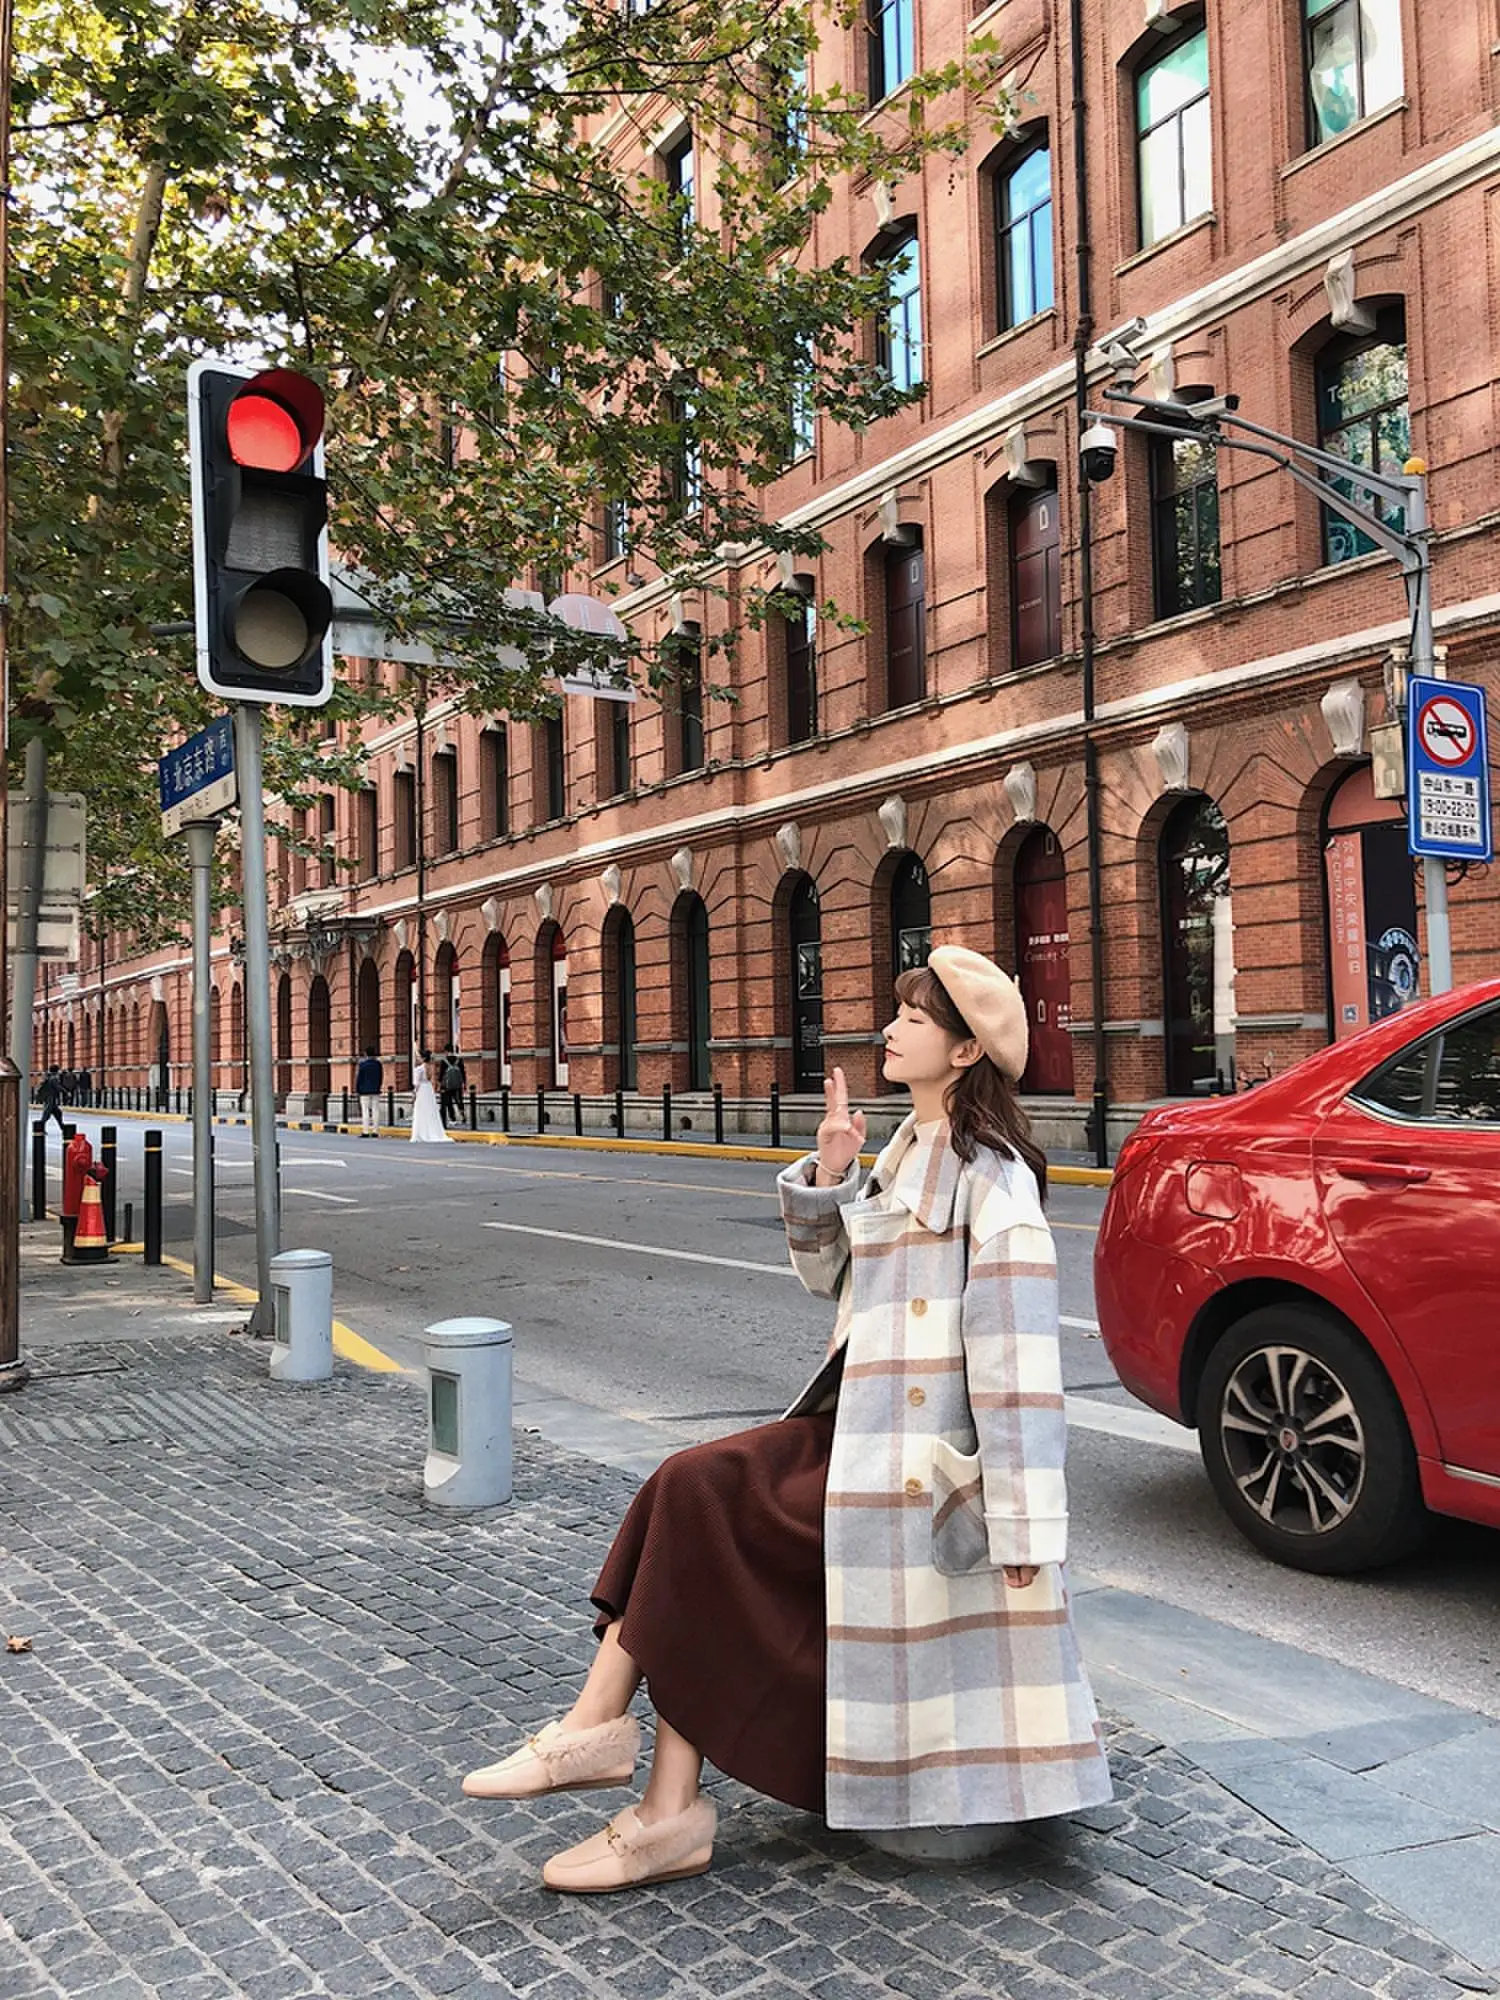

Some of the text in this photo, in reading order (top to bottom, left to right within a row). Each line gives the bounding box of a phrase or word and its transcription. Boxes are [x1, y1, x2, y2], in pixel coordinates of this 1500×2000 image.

[173, 736, 215, 792] 北京东路
[1423, 776, 1473, 796] 中山东一路
